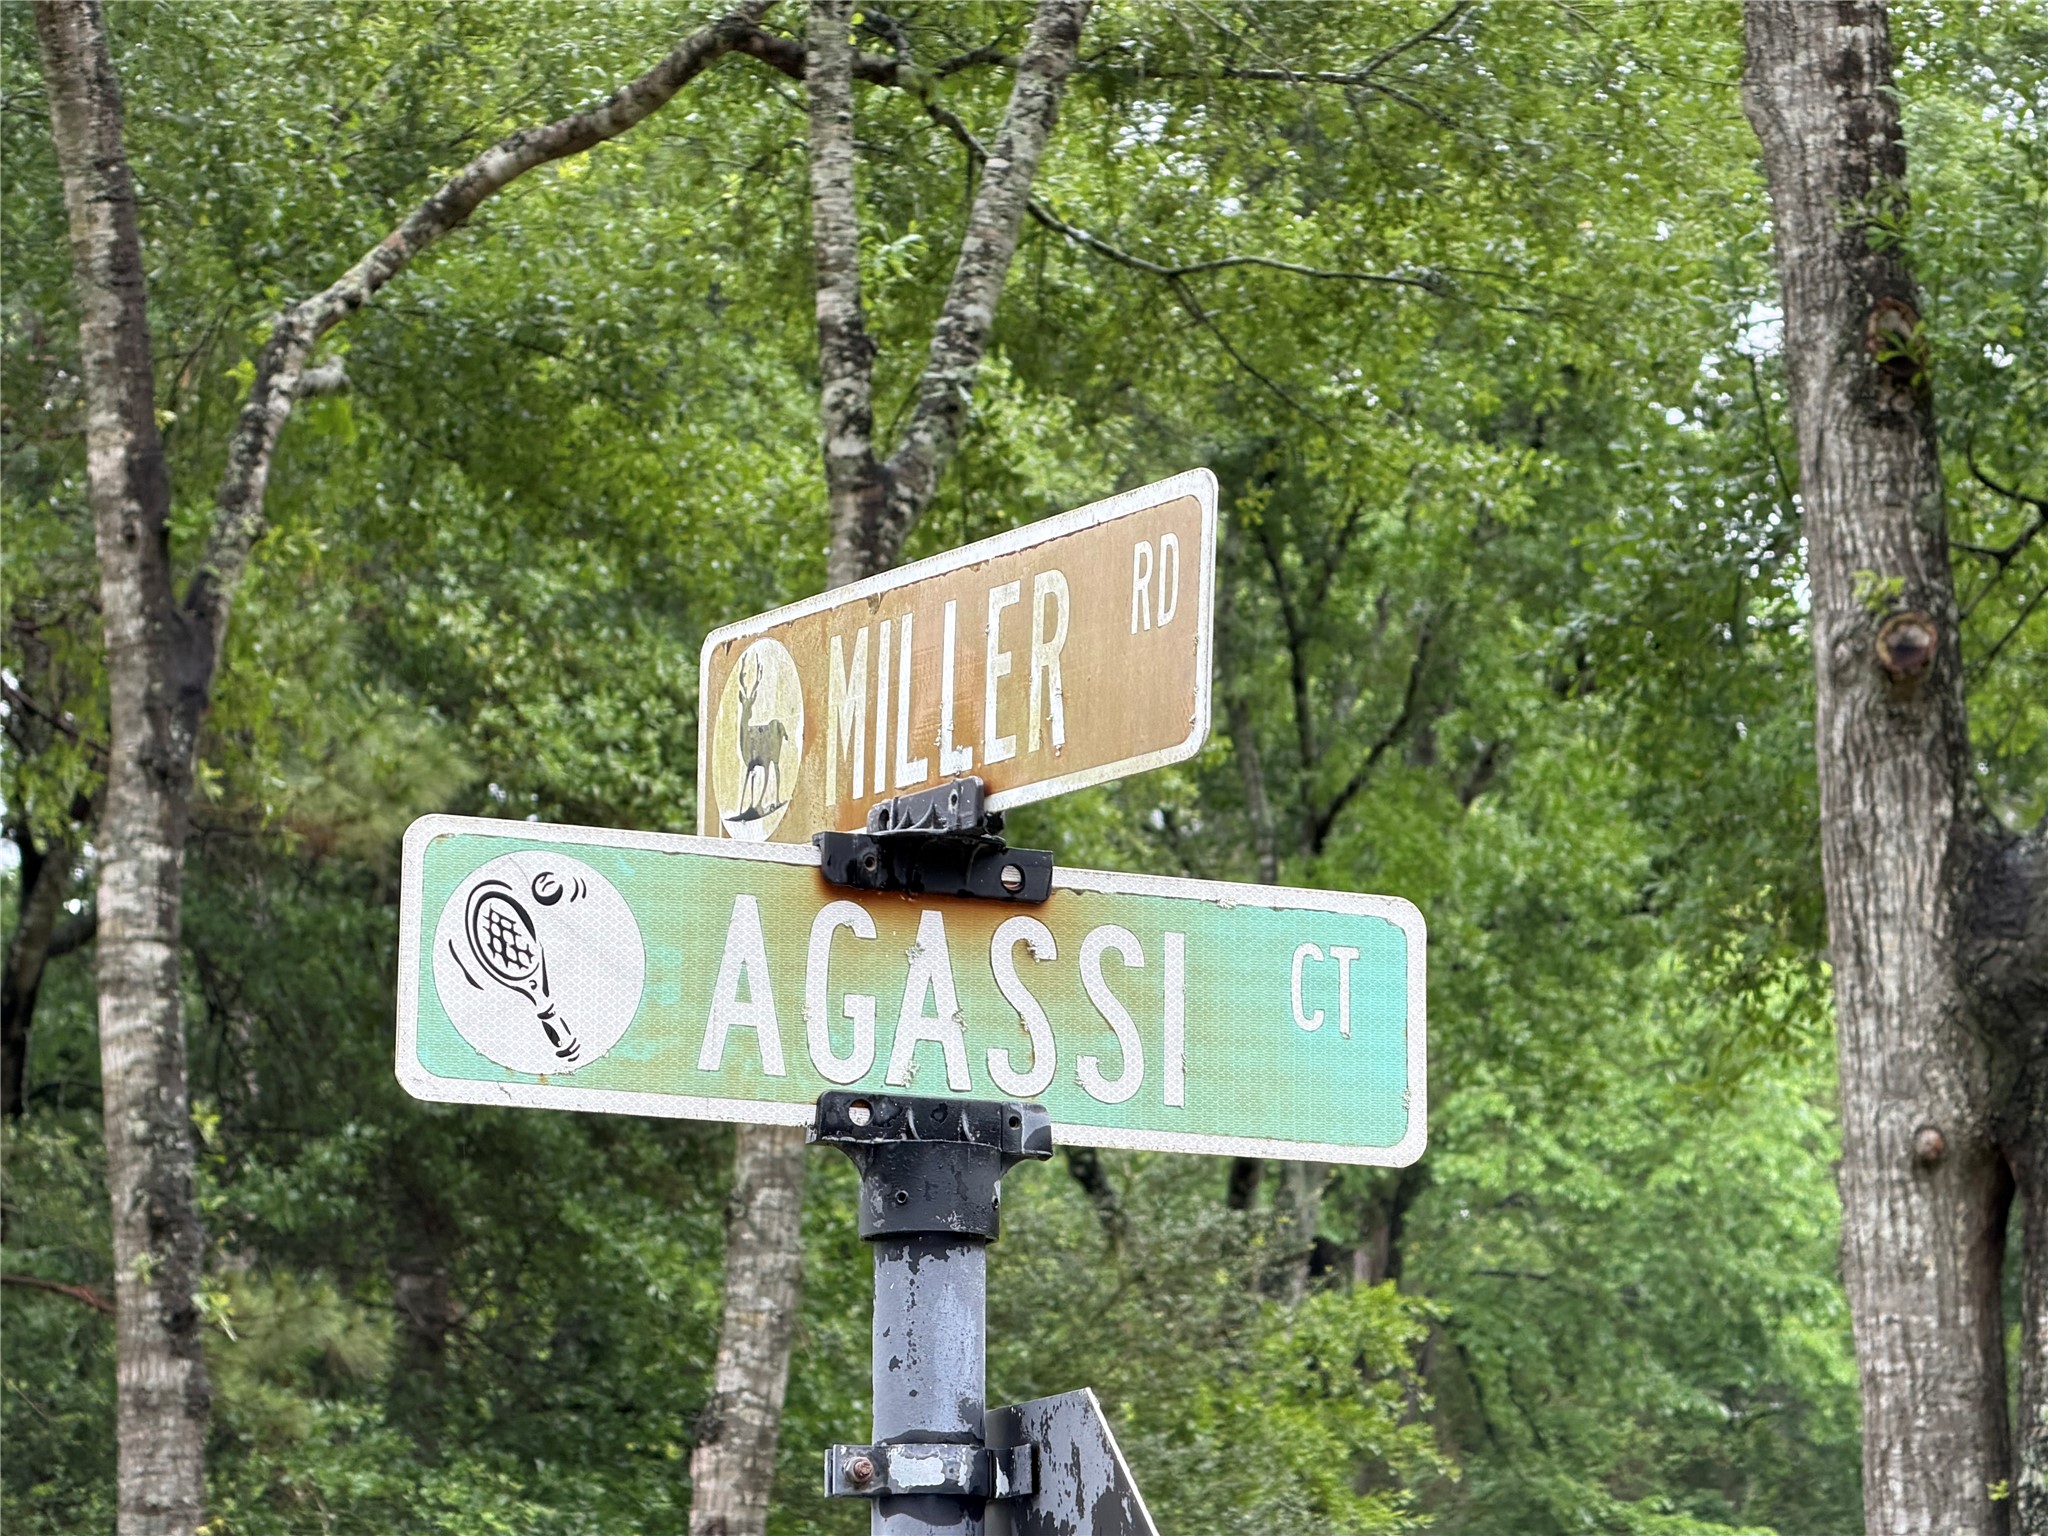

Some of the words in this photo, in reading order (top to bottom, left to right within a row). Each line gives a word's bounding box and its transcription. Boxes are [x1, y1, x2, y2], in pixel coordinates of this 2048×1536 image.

[825, 568, 1070, 807] MILLER
[1130, 532, 1180, 635] RD
[696, 893, 1186, 1108] AGASSI
[1290, 942, 1360, 1038] CT
